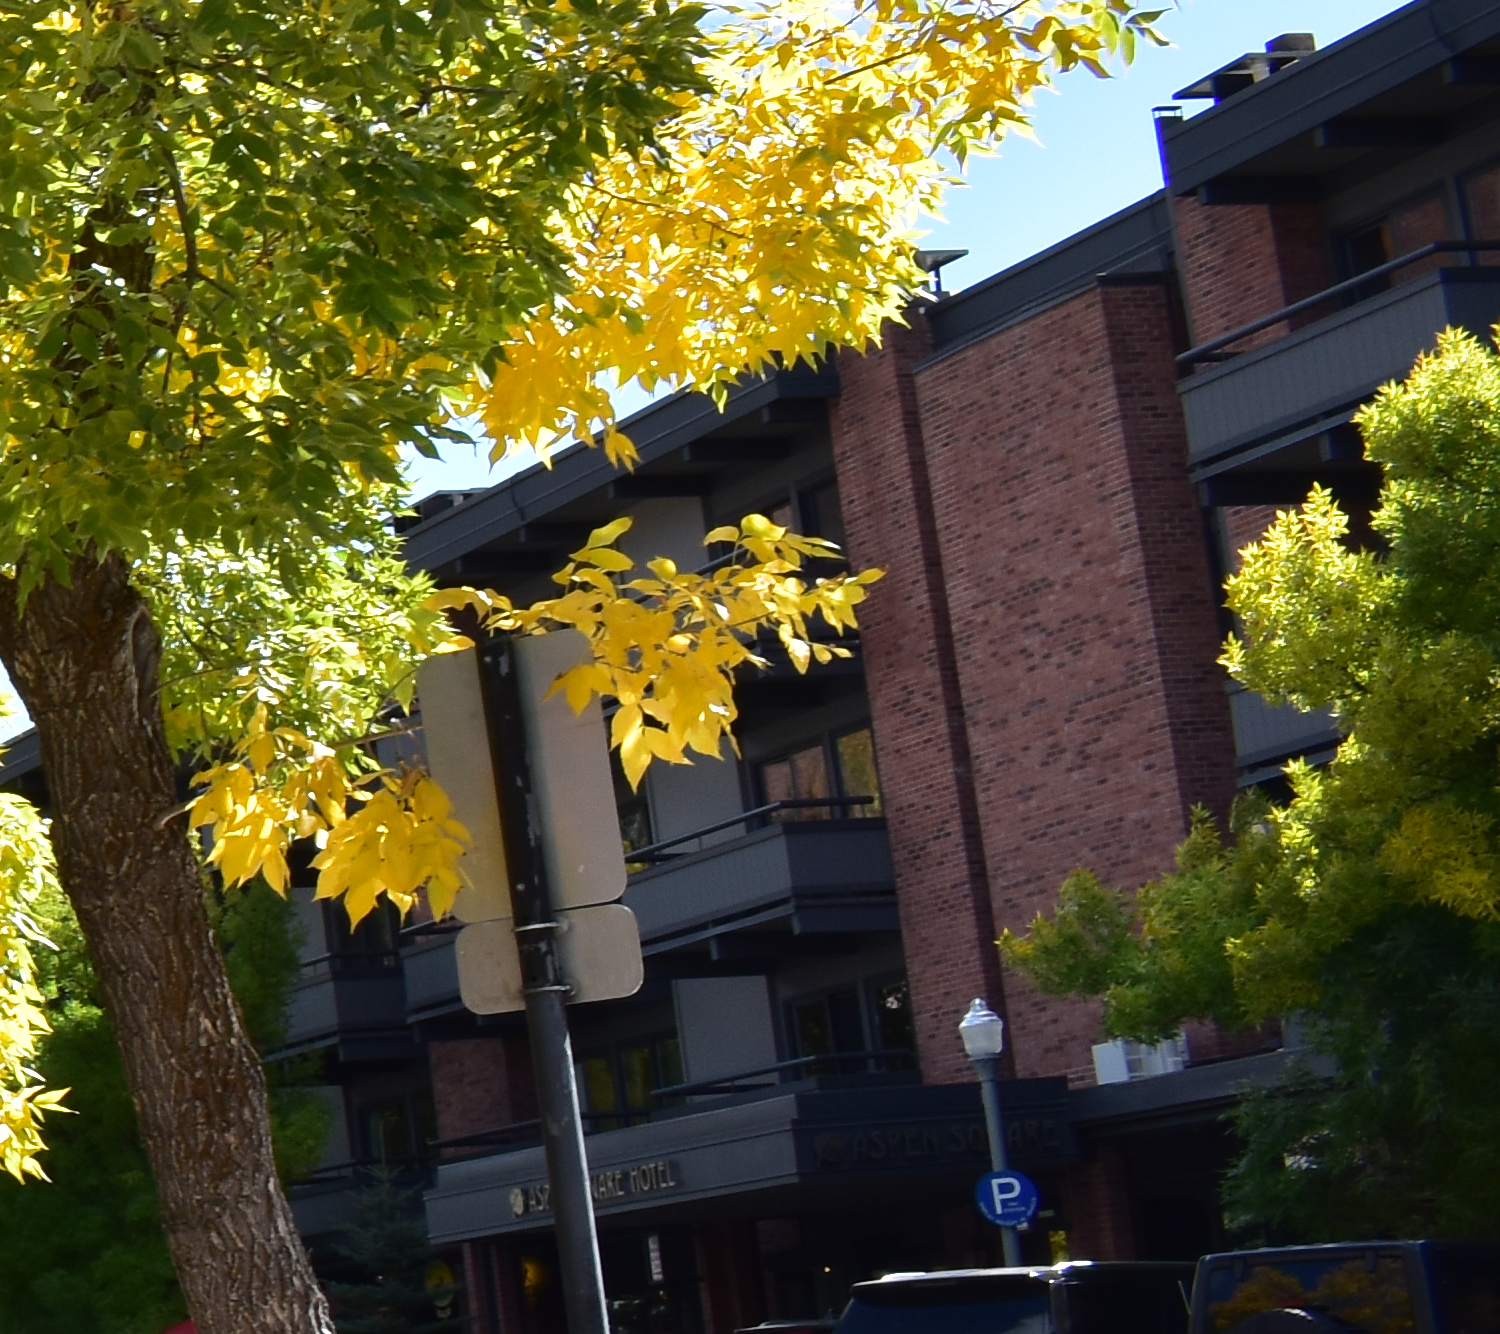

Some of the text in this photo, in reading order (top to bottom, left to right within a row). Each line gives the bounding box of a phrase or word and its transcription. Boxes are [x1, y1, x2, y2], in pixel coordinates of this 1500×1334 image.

[950, 1118, 1061, 1153] SQARE
[630, 1160, 676, 1193] HOTEL
[991, 1177, 1021, 1215] P
